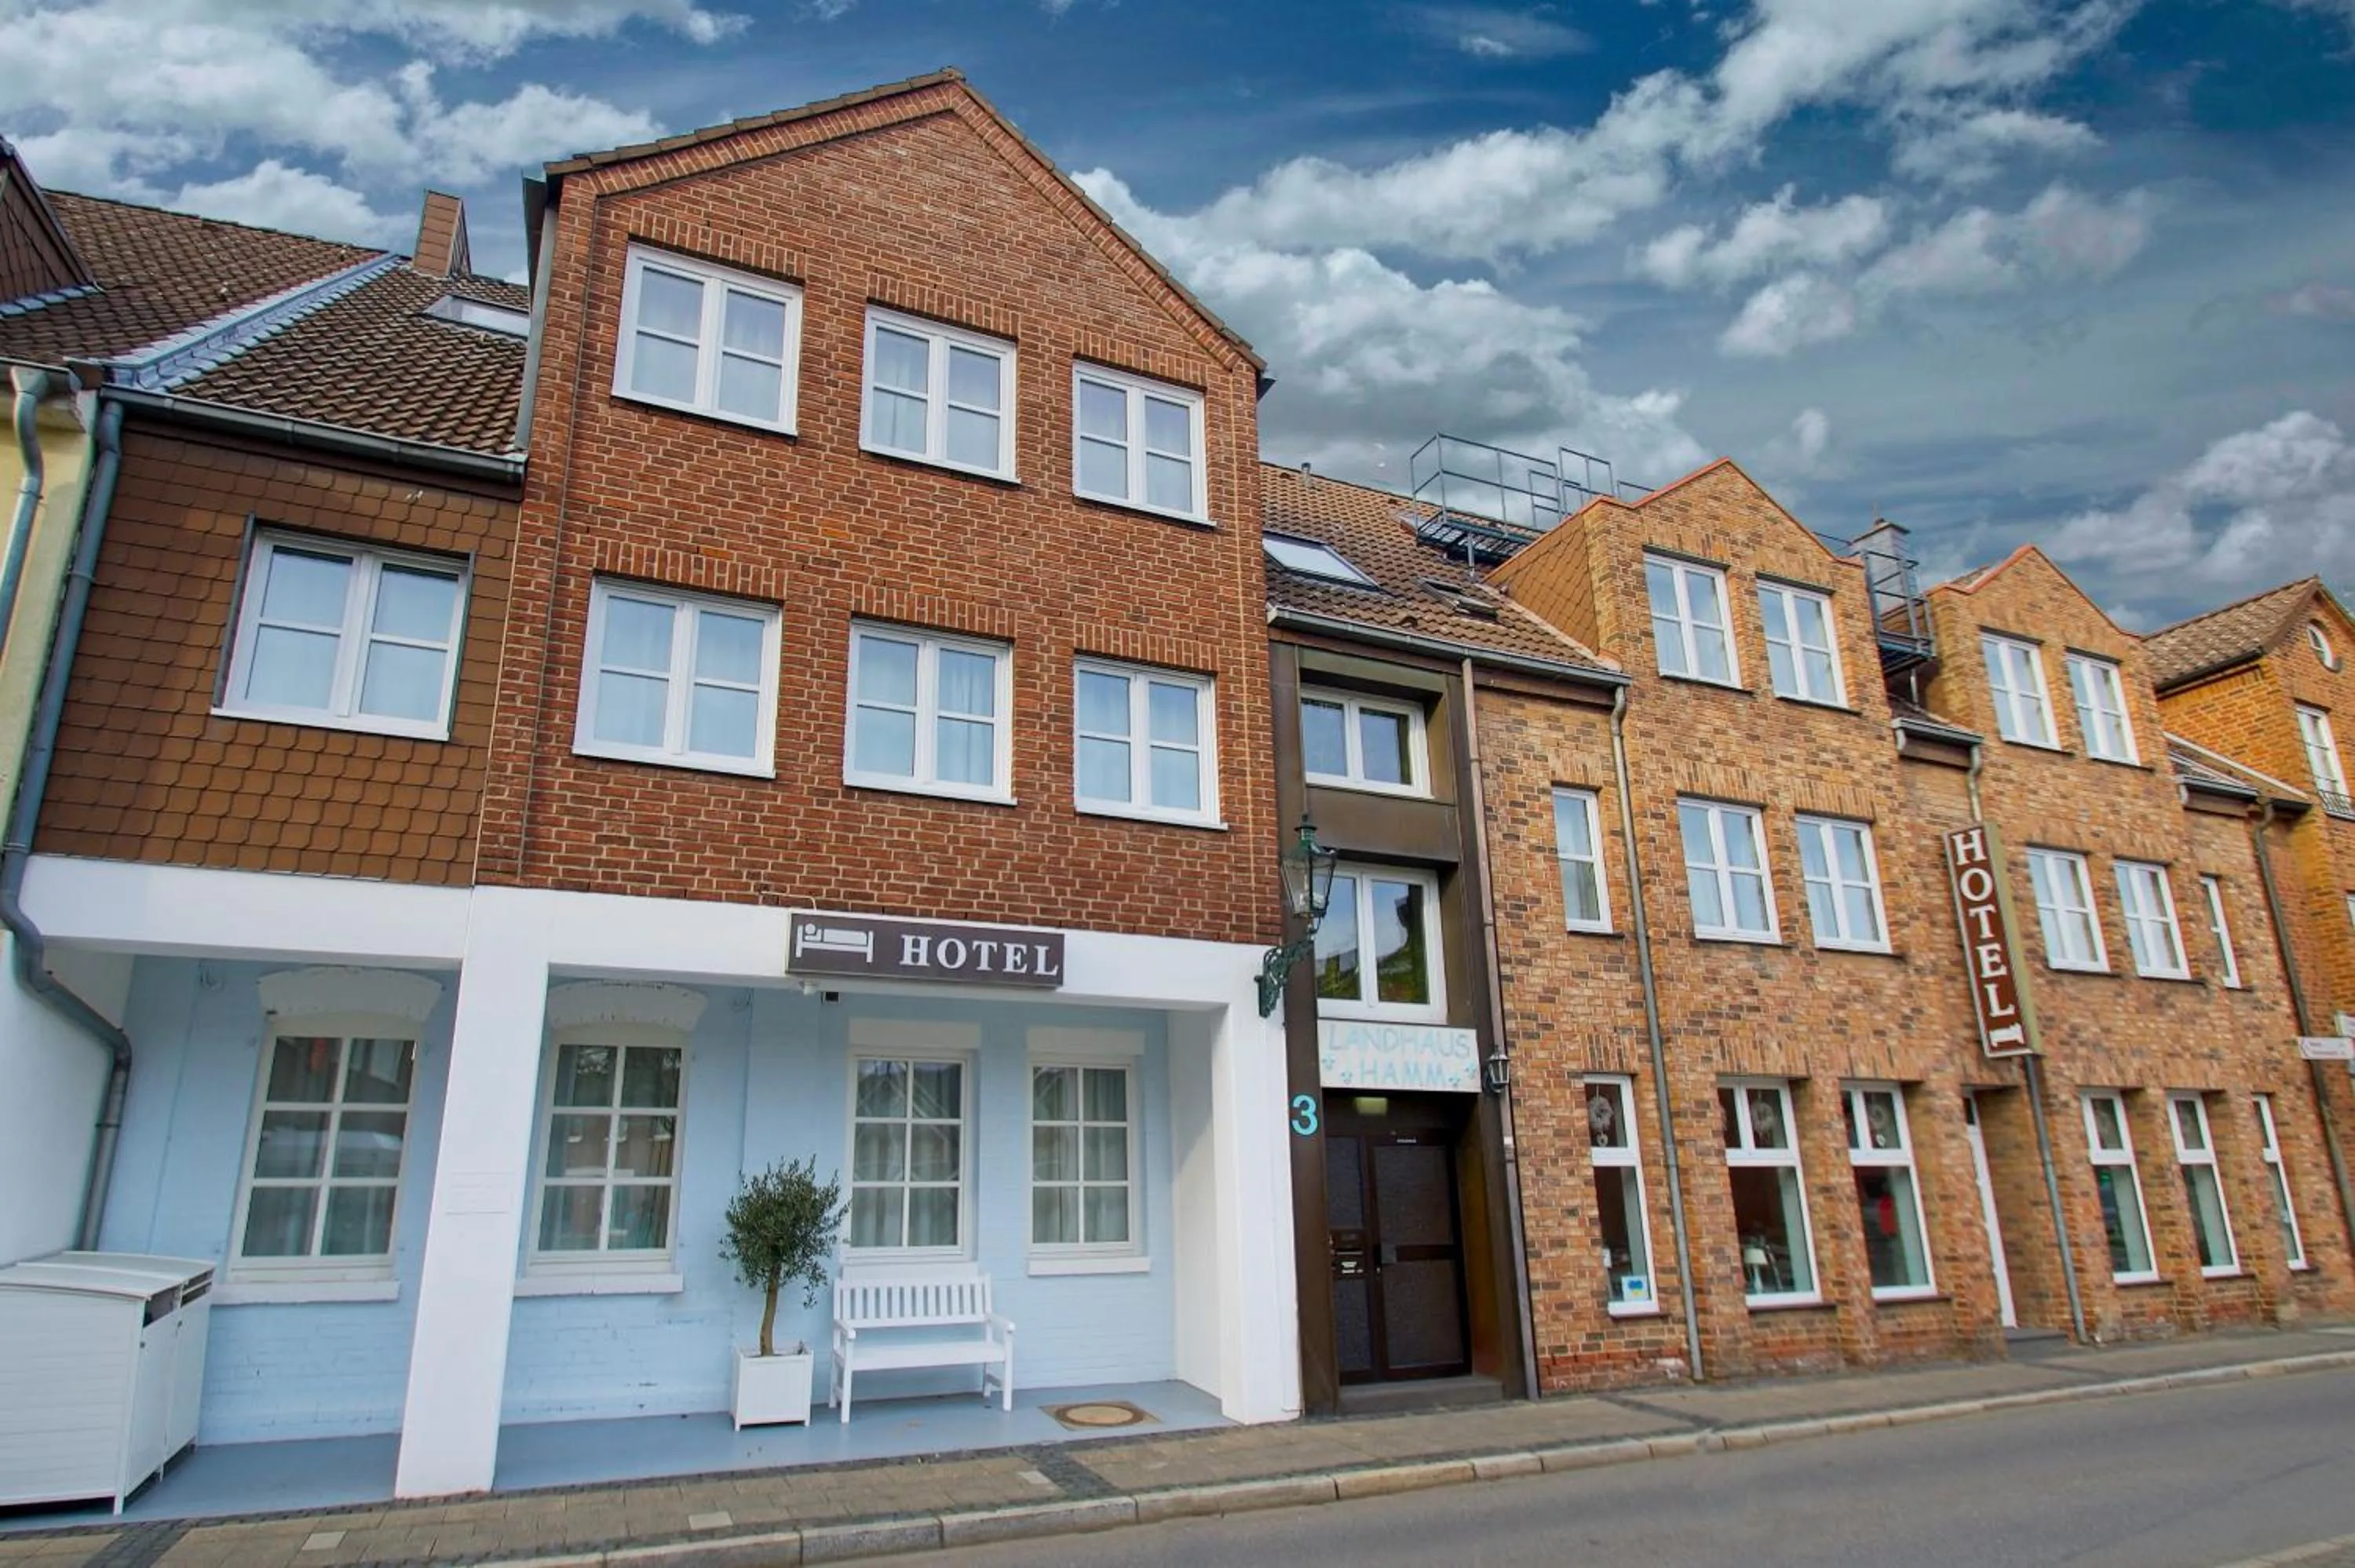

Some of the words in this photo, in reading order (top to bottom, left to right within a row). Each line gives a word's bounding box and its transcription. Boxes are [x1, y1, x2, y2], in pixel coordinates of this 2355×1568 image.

[1952, 829, 2014, 1017] HOTEL
[900, 935, 1058, 975] HOTEL
[1327, 1025, 1471, 1058] LANDHAUS
[1360, 1061, 1447, 1087] HAMM
[1291, 1095, 1319, 1136] 3
